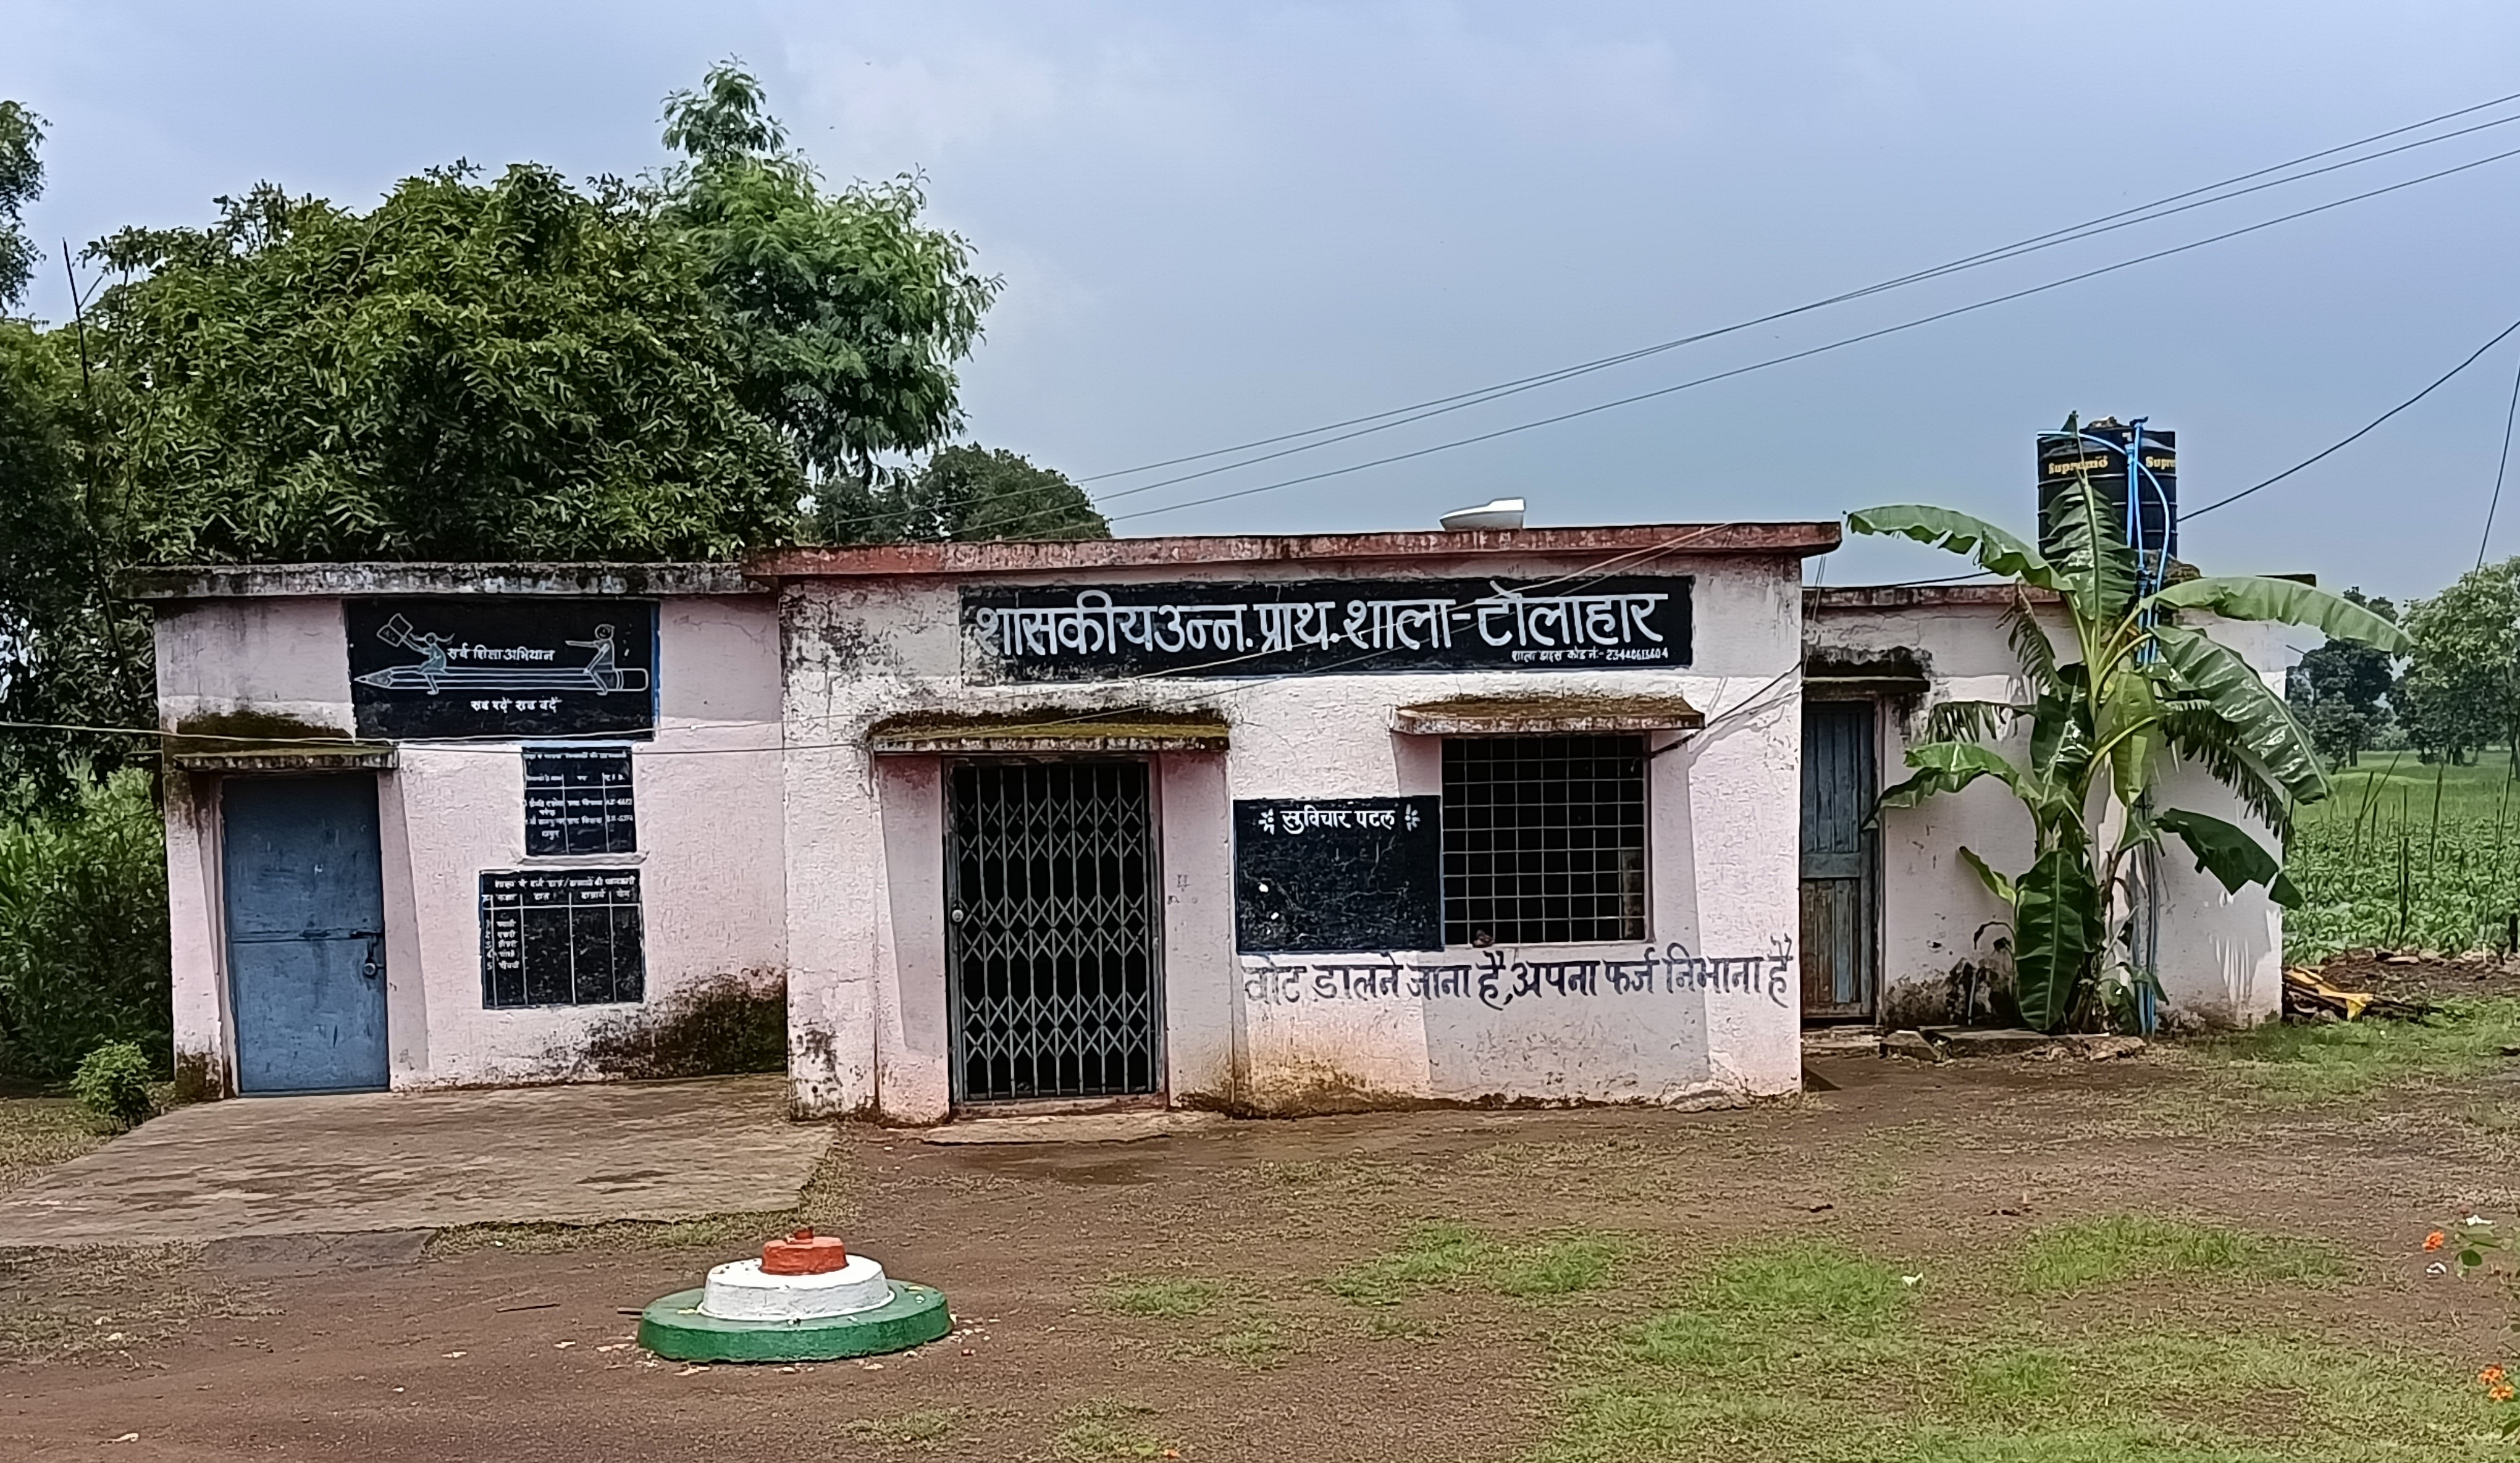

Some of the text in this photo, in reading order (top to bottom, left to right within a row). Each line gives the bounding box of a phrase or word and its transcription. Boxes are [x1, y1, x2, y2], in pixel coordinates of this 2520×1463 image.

[1280, 805, 1396, 834] सुविचार पटल
[1311, 953, 1404, 1002] डालने
[1406, 964, 1472, 1000] जाना
[1511, 959, 1600, 997] अपना
[1661, 942, 1765, 994] निभाना
